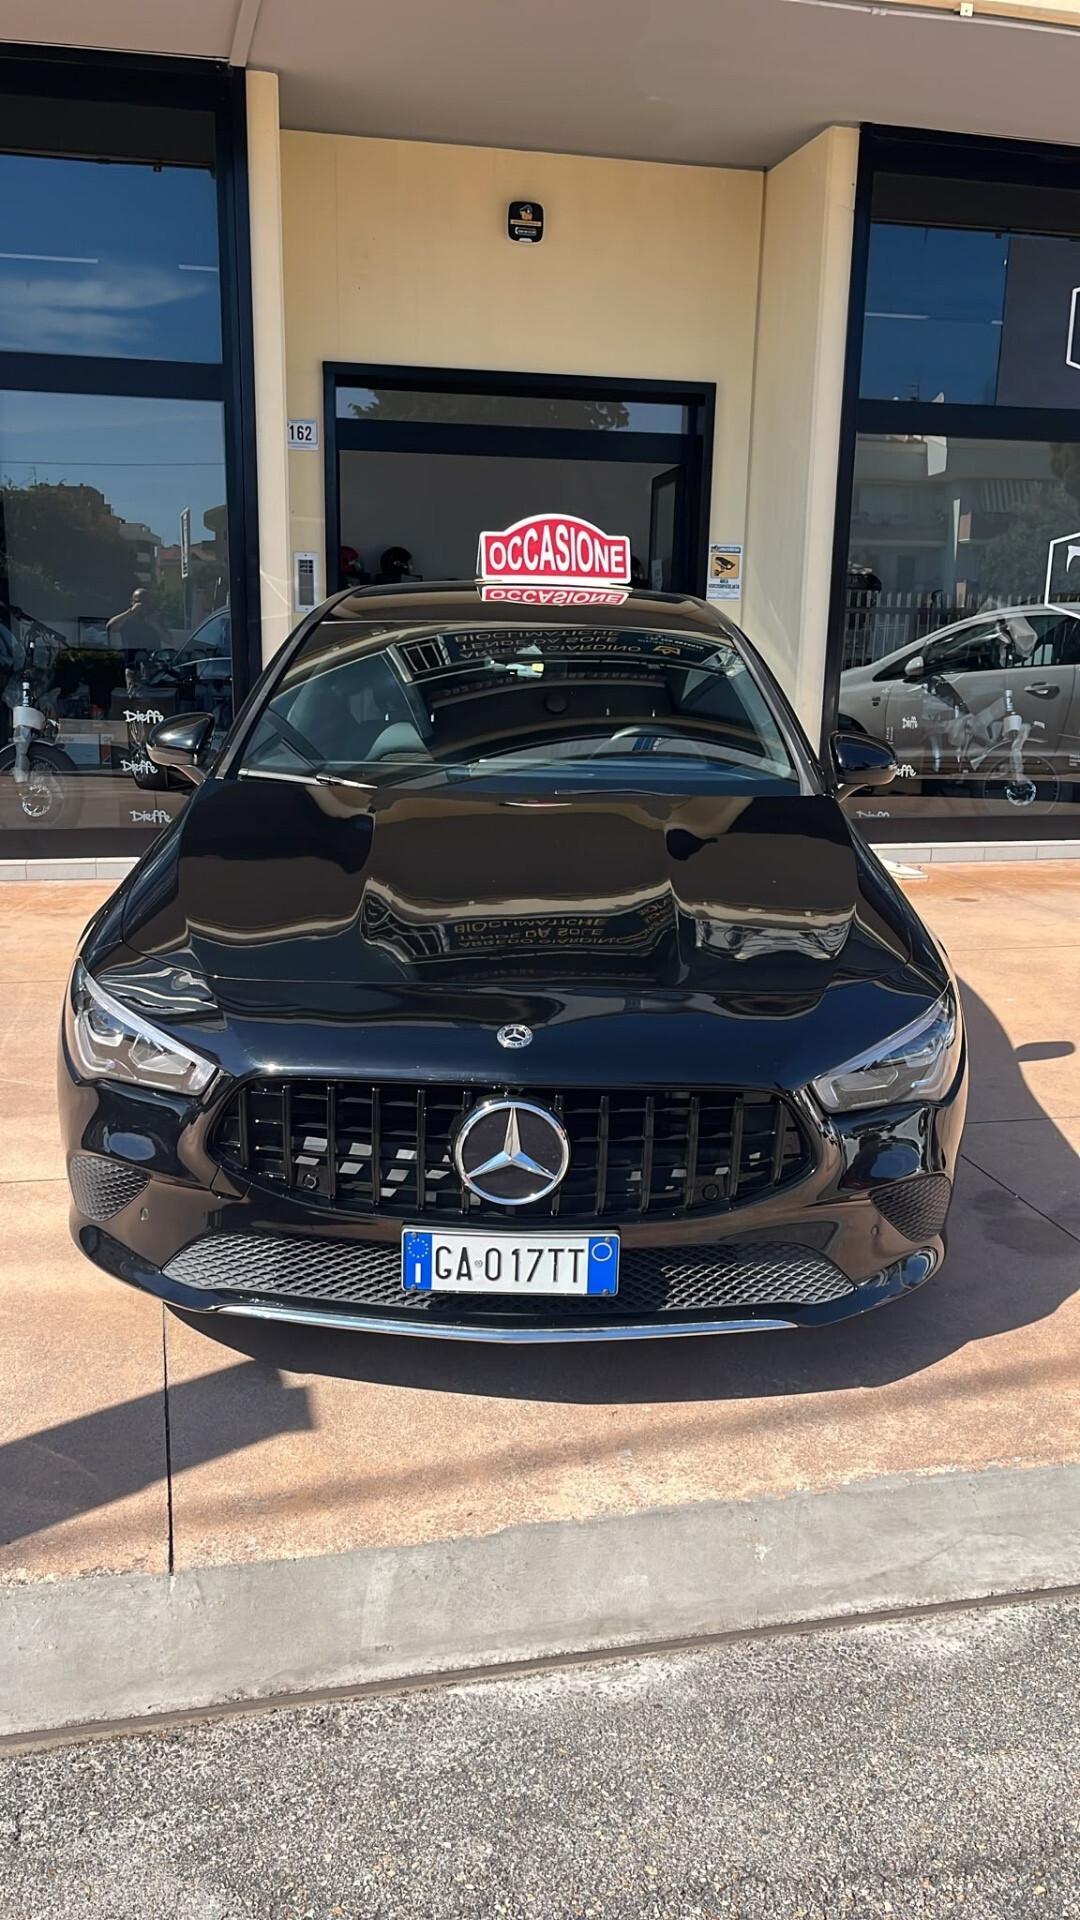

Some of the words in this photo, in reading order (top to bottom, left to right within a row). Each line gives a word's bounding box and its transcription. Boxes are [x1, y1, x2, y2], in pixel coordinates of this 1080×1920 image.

[289, 425, 312, 441] 162
[489, 524, 625, 573] OCCASIONE
[120, 759, 158, 774] Dieffe
[896, 764, 917, 778] effe
[129, 810, 173, 823] Dieffe
[415, 1263, 421, 1283] I
